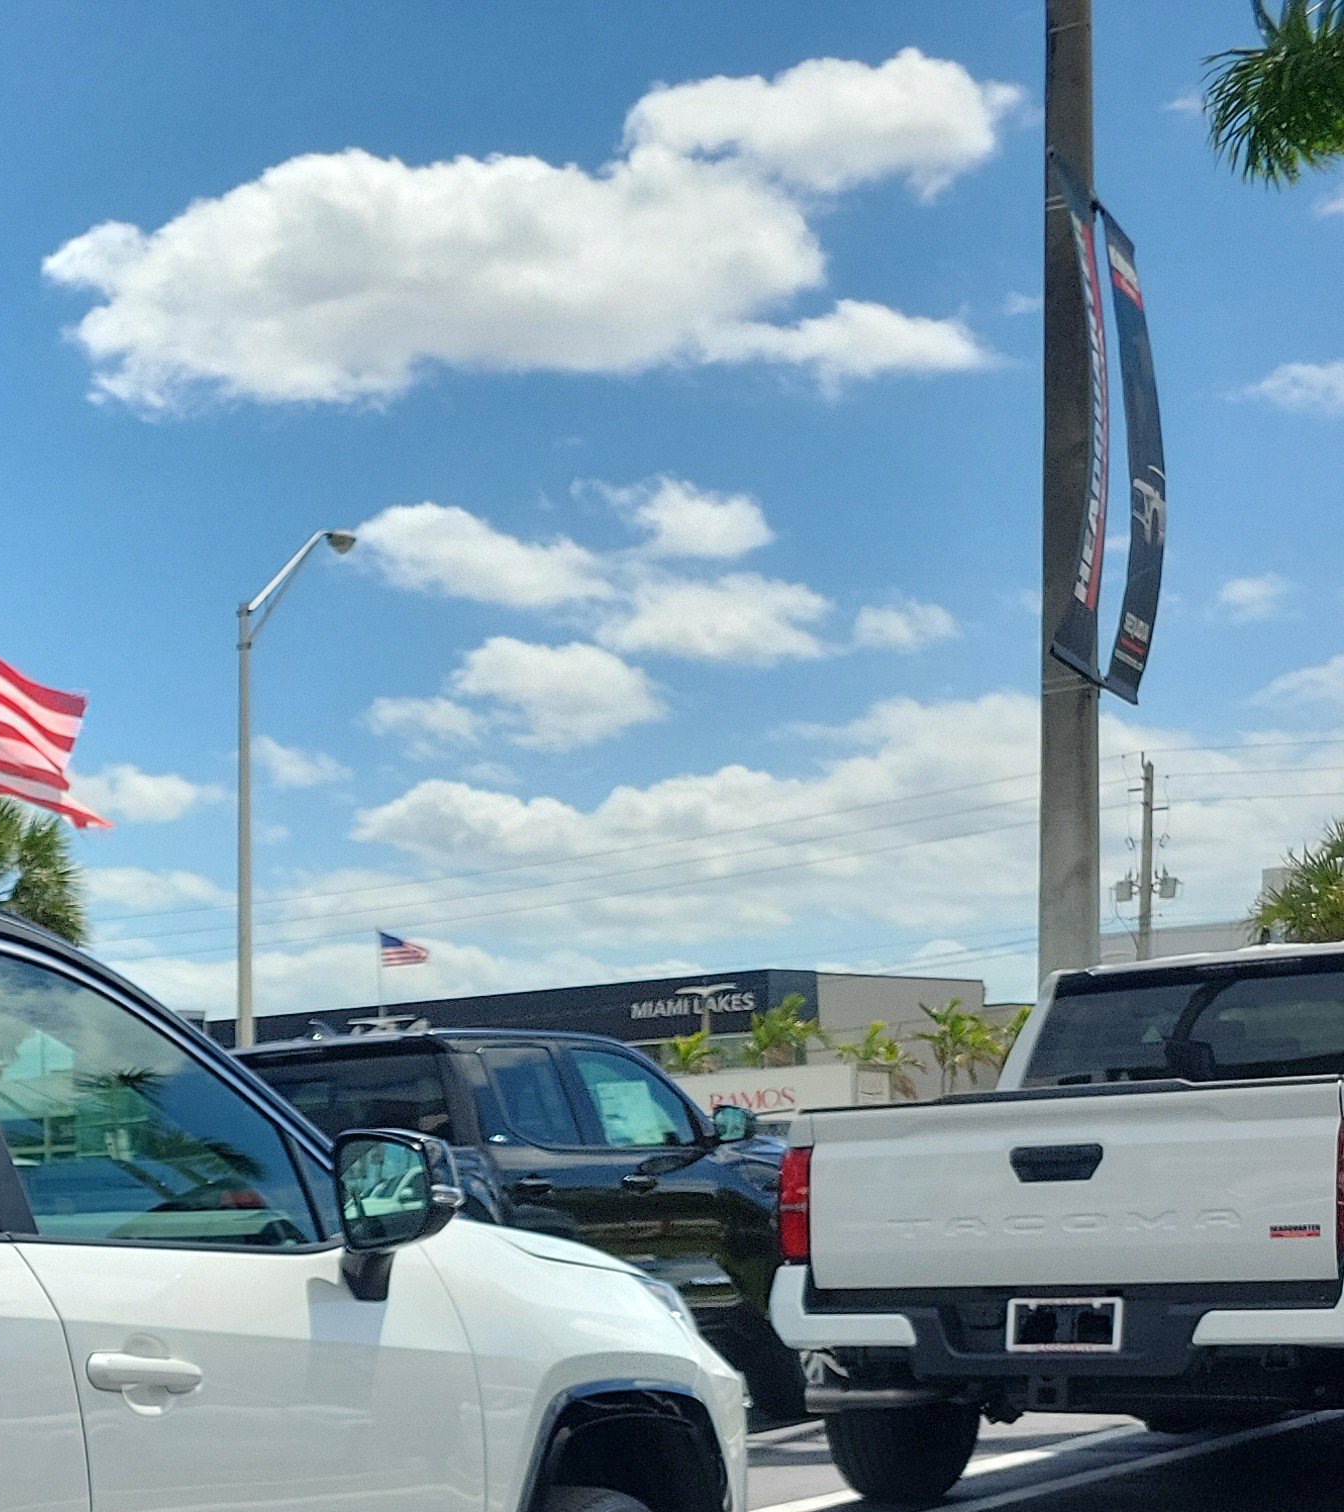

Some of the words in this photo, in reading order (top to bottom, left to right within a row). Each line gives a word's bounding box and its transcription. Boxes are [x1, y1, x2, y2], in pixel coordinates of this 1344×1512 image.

[630, 998, 690, 1020] MIAMI
[692, 991, 757, 1016] LAKES
[886, 1207, 1242, 1239] TACOMA
